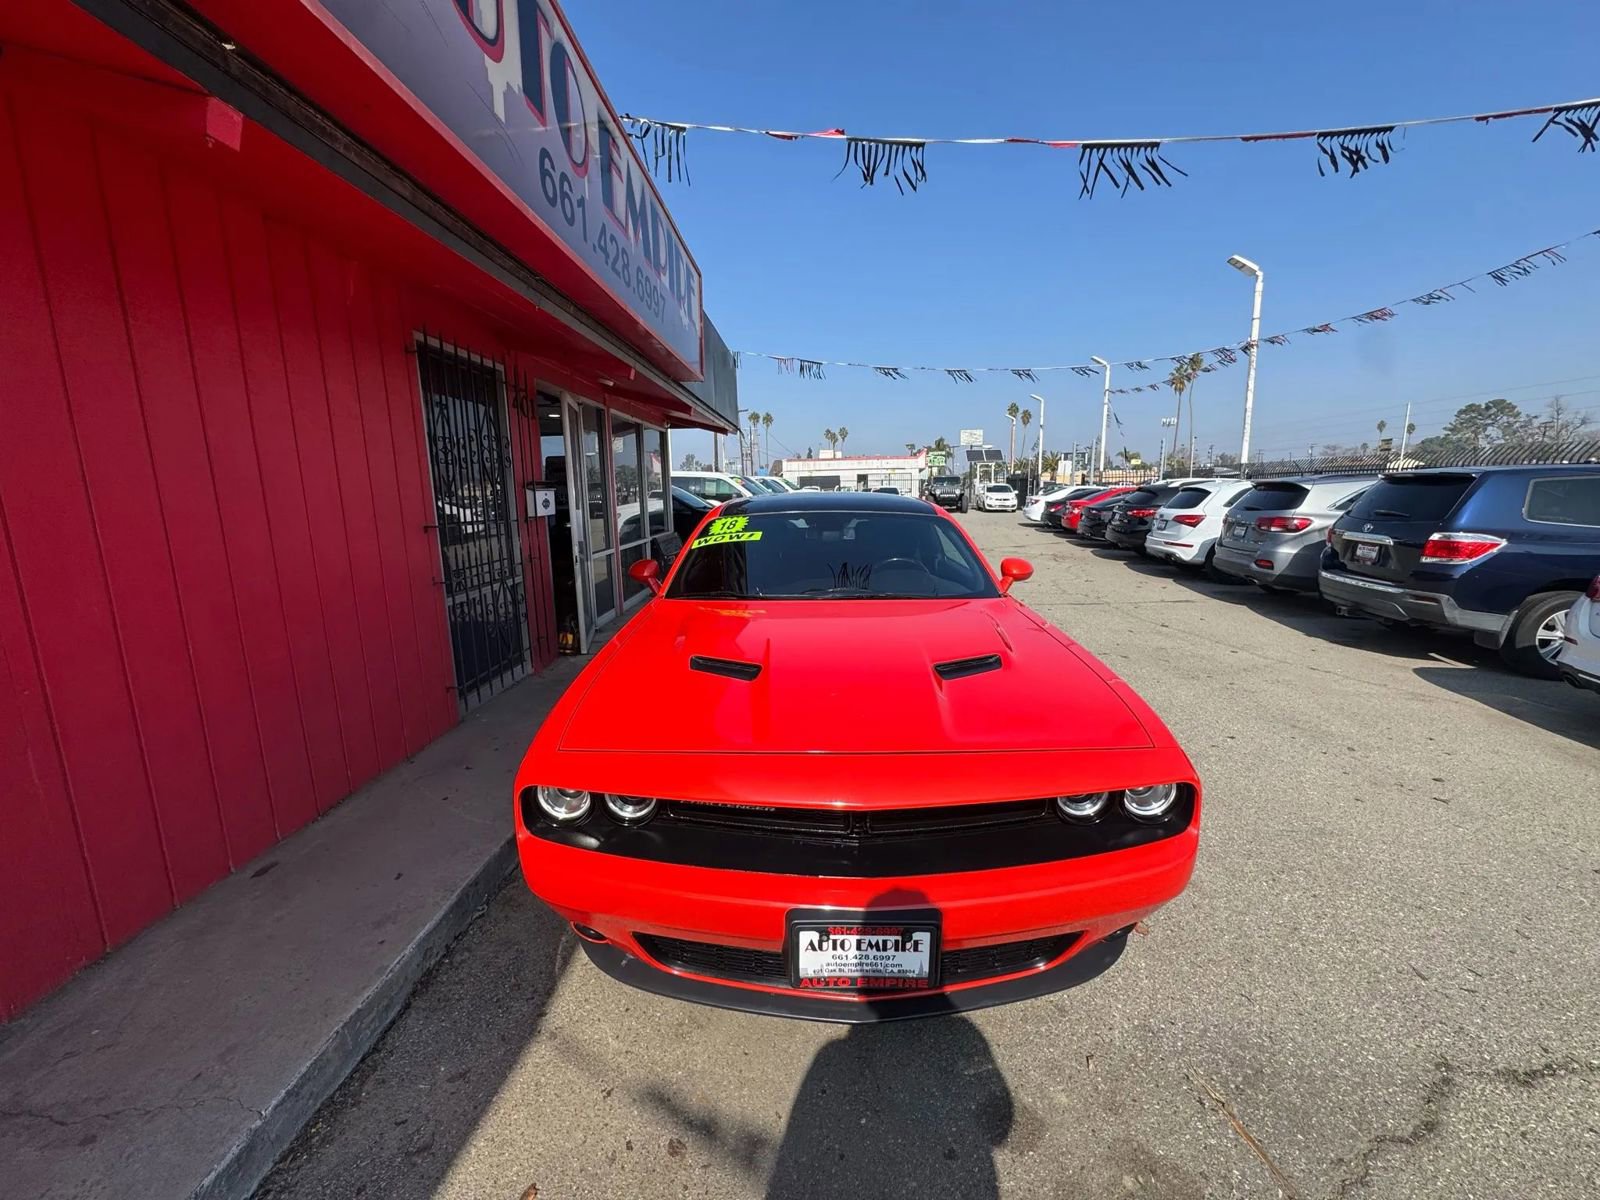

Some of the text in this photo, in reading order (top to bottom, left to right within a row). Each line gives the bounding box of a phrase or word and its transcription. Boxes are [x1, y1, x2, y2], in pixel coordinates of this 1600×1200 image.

[539, 147, 667, 322] 661.428.6997
[720, 519, 739, 531] 18
[697, 533, 755, 546] WOW!
[805, 938, 924, 953] AUTO EMPIRE
[832, 953, 897, 962] 661.428.6997
[800, 977, 929, 988] AUTO EMPIRE
